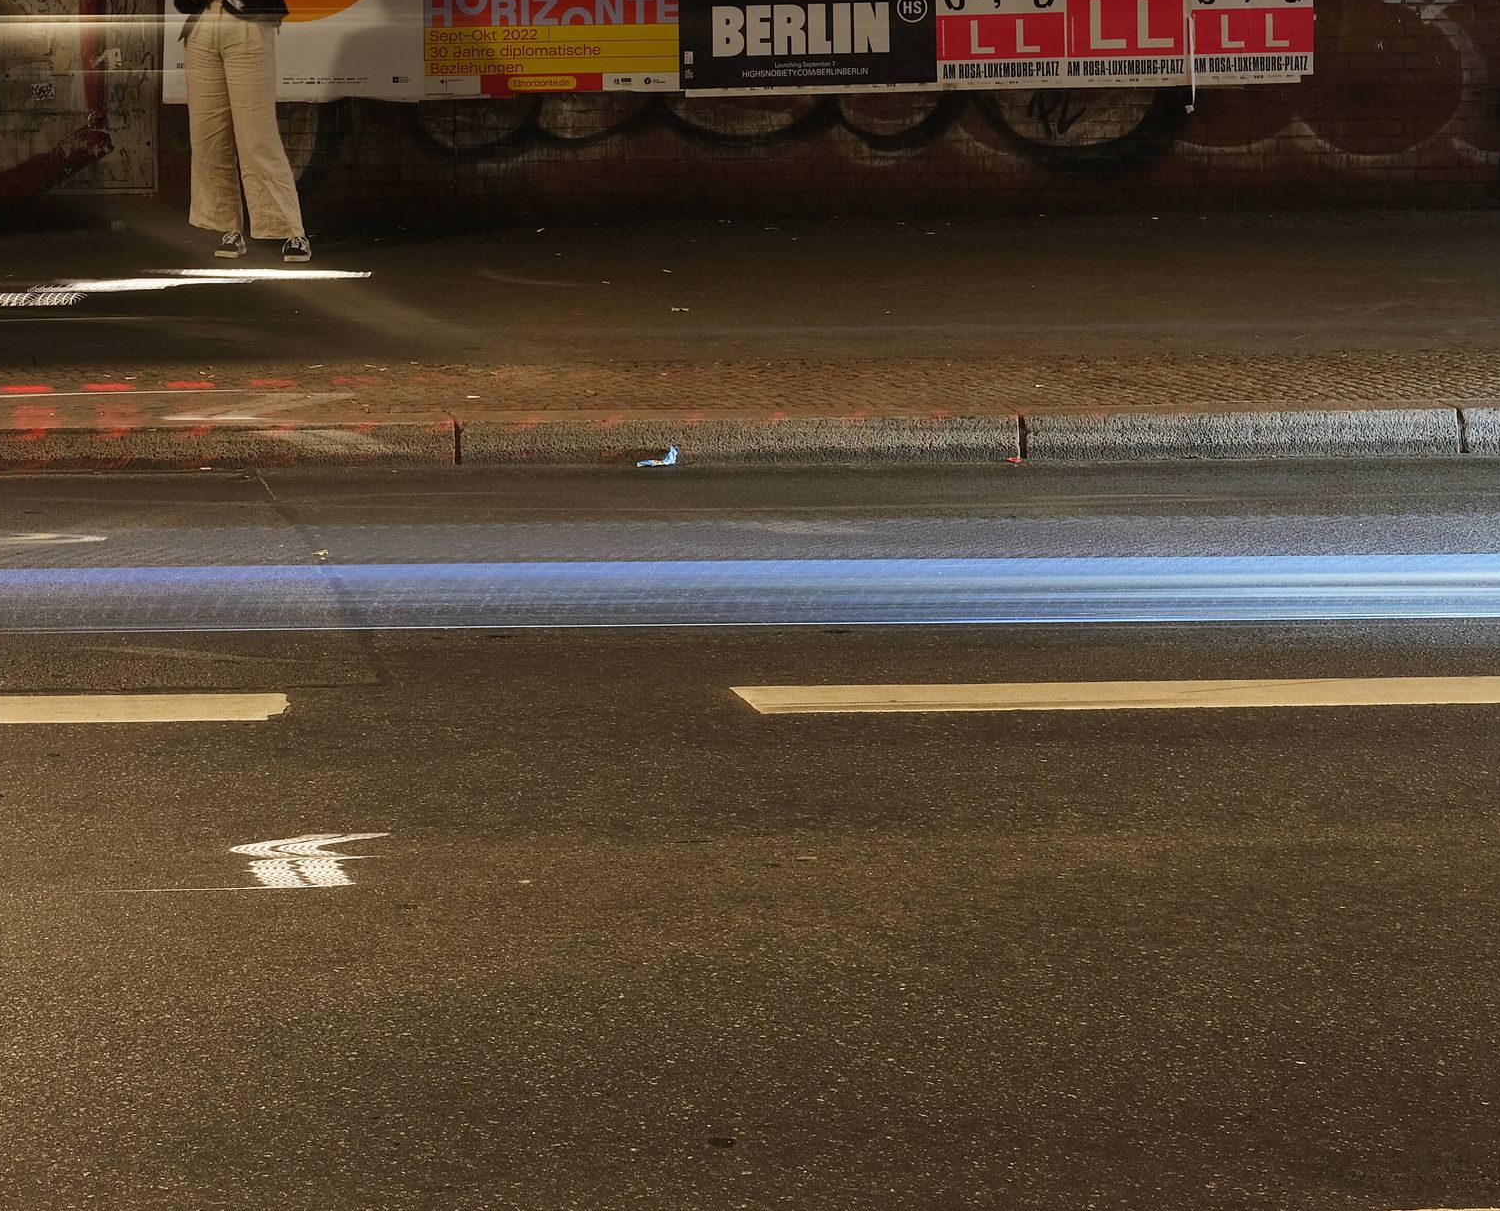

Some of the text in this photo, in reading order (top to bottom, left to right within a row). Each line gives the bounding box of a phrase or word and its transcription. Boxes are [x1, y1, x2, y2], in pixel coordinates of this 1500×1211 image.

[903, 1, 922, 15] HS
[503, 29, 537, 40] 2022
[712, 2, 890, 57] BERLIN
[430, 44, 601, 59] 30 Jahre diplomatische
[431, 62, 524, 75] Beziehungen
[943, 61, 1059, 79] AM ROSA-LUXEMBURG-PLATZ
[1067, 58, 1184, 76] AM ROSA-LUXEMBURG-PLATZ
[1194, 56, 1308, 74] AM ROSA-LUXEMBURG-PLATZ
[742, 68, 869, 78] HIGHSNOBIETY.COM/BERLINBERLIN
[512, 78, 569, 87] 13horizonte.de
